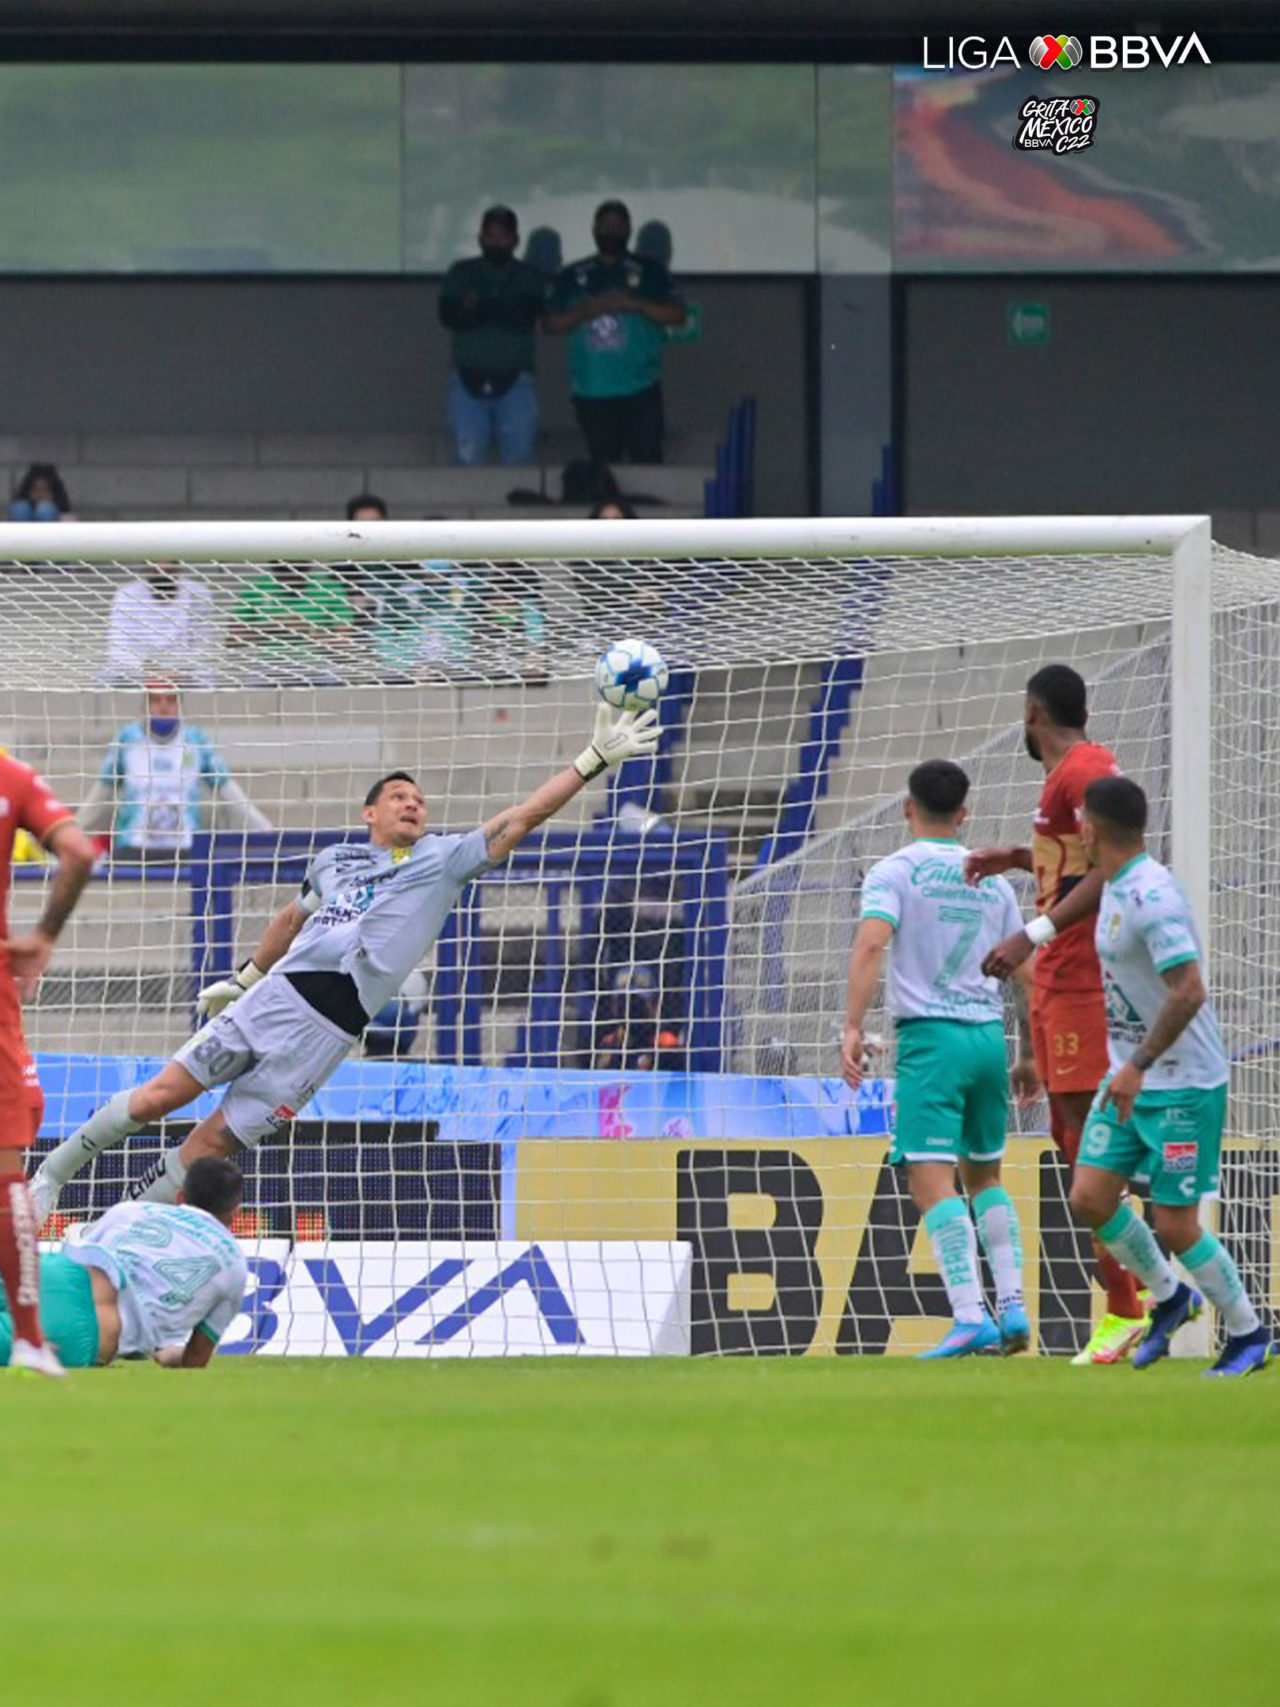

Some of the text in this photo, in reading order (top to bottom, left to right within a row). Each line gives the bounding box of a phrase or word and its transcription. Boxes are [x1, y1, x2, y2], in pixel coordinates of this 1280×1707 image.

[933, 904, 983, 989] 7
[193, 1035, 235, 1076] 30
[1053, 1032, 1080, 1056] 33
